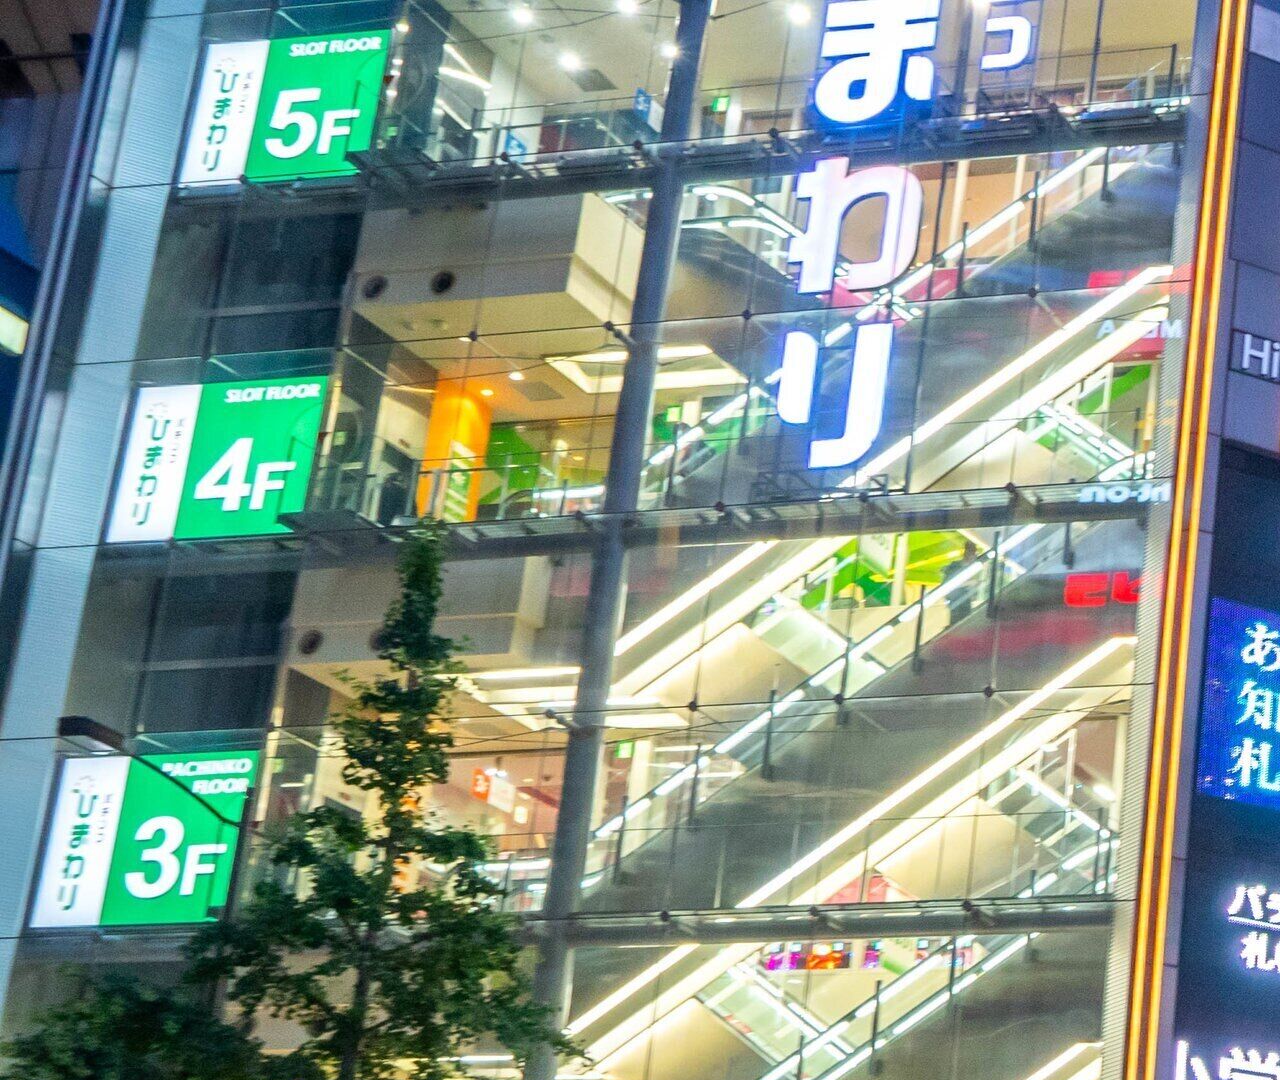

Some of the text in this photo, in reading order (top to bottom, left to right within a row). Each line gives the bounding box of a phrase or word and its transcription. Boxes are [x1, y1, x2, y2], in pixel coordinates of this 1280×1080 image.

[289, 37, 382, 57] SLOT FLOOR
[265, 88, 360, 159] 5F
[224, 384, 320, 403] SLOT FLOOR
[193, 437, 296, 512] 4F
[125, 815, 228, 898] 3F
